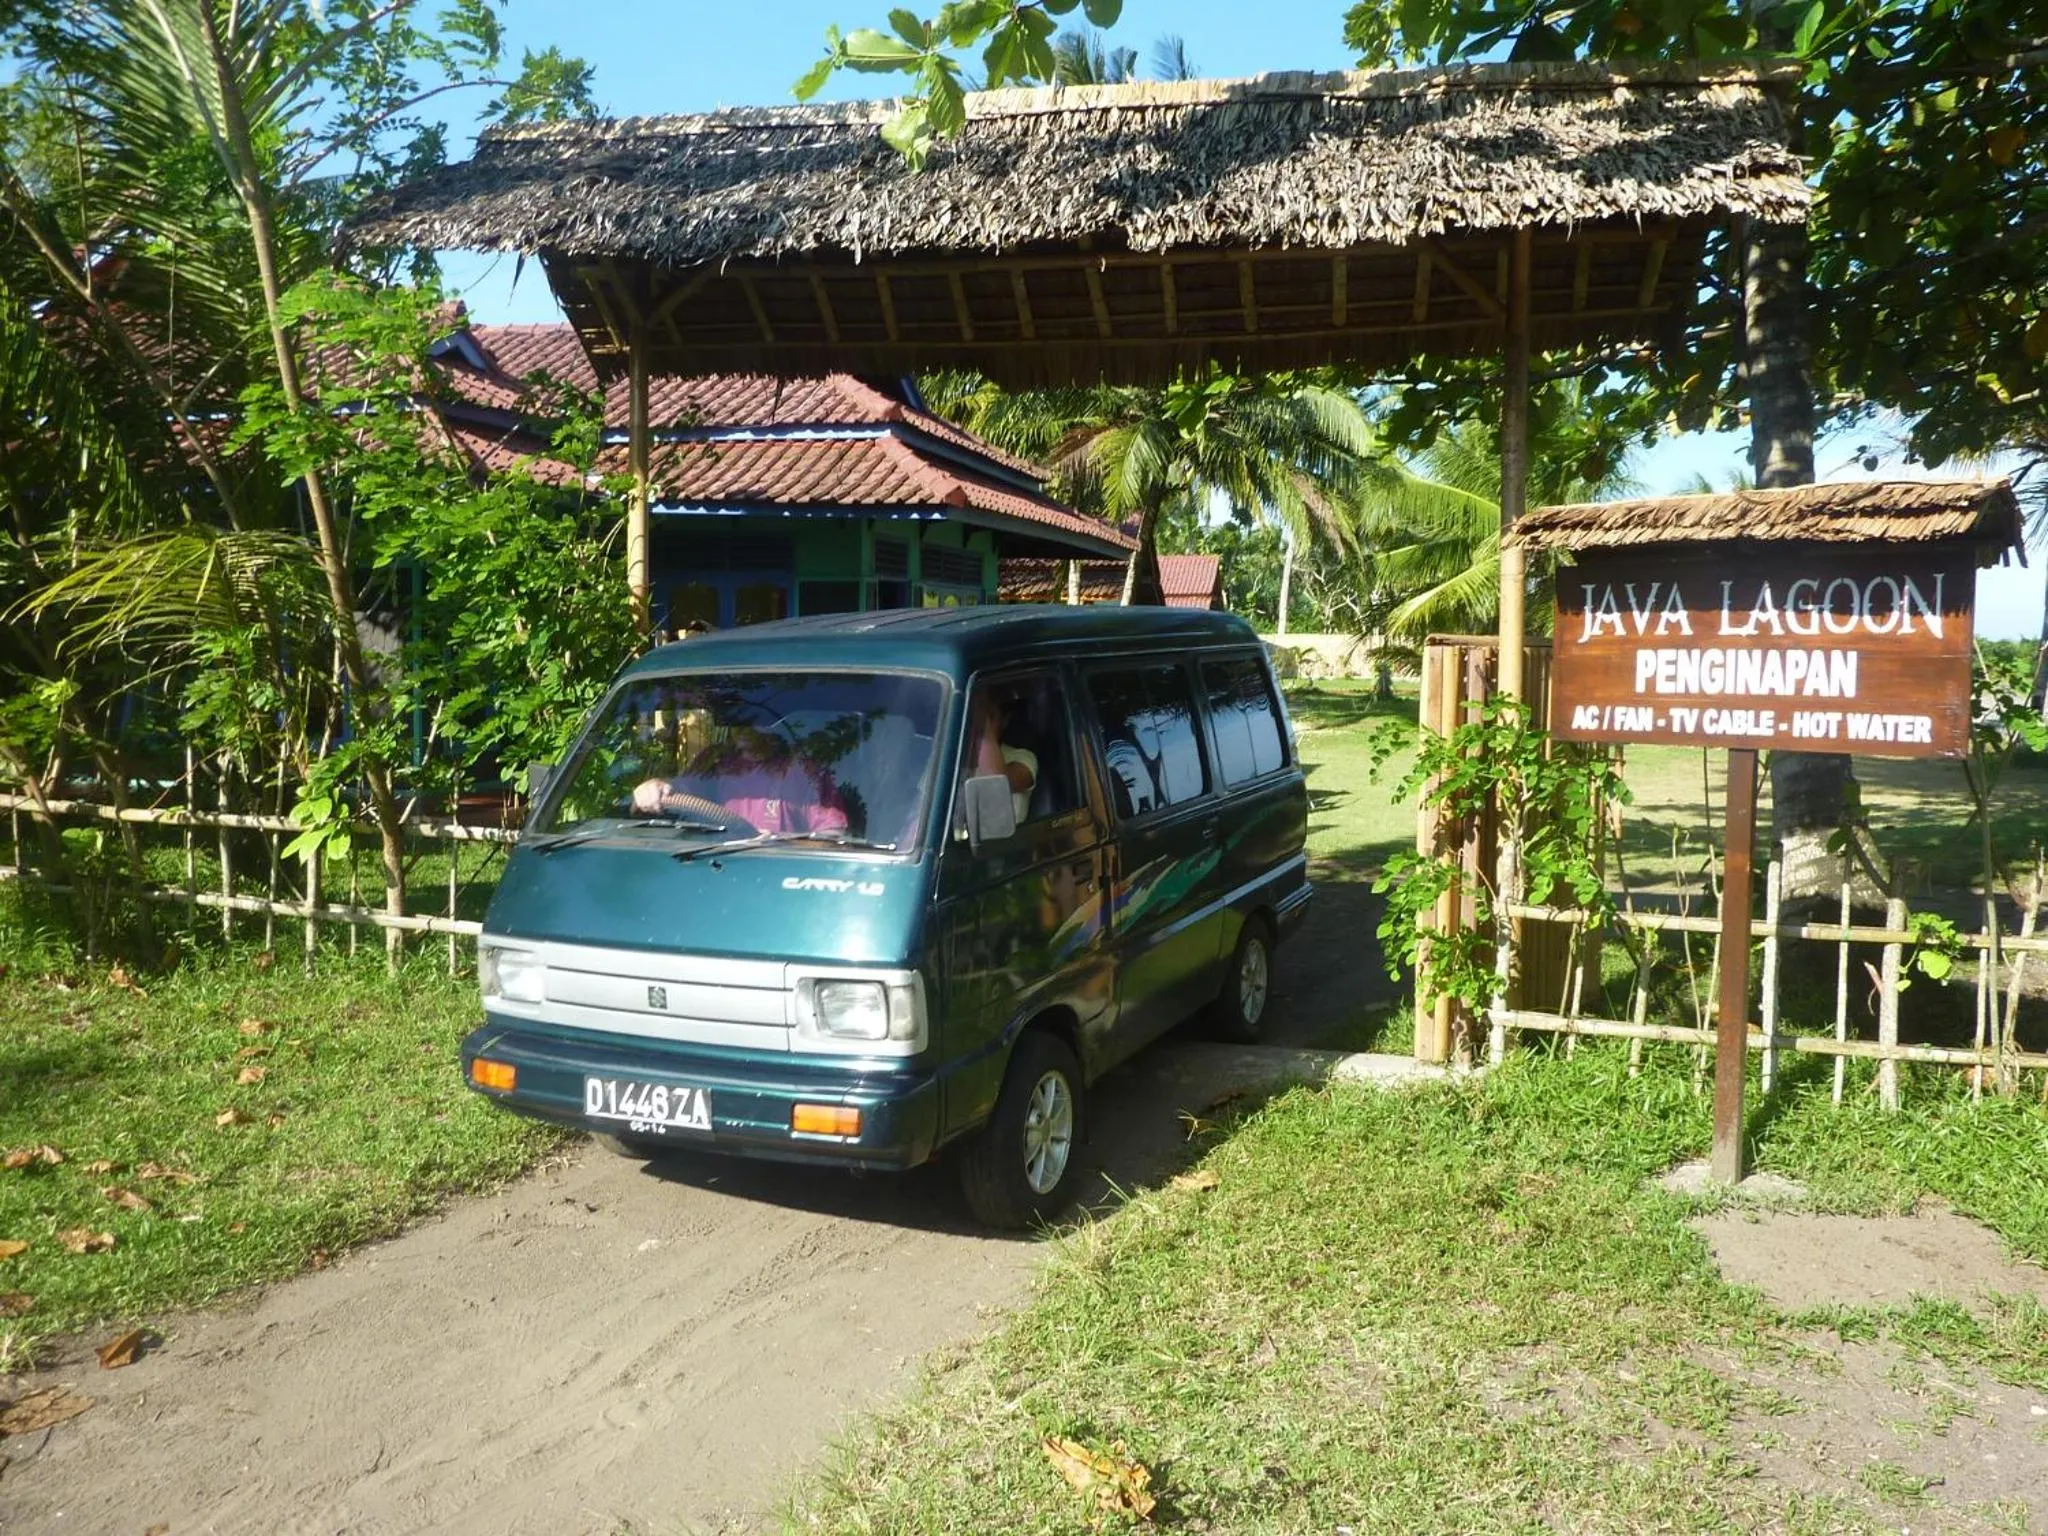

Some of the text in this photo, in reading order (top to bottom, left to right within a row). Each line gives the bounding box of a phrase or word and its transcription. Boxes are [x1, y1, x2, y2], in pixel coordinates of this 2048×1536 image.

[1578, 573, 1944, 643] JAVA LAGOON
[1635, 648, 1858, 698] PENGINAPAN
[1669, 709, 1702, 734] TV
[1703, 710, 1774, 737] CABLE
[1793, 711, 1842, 739] HOT
[1848, 713, 1932, 743] WATER
